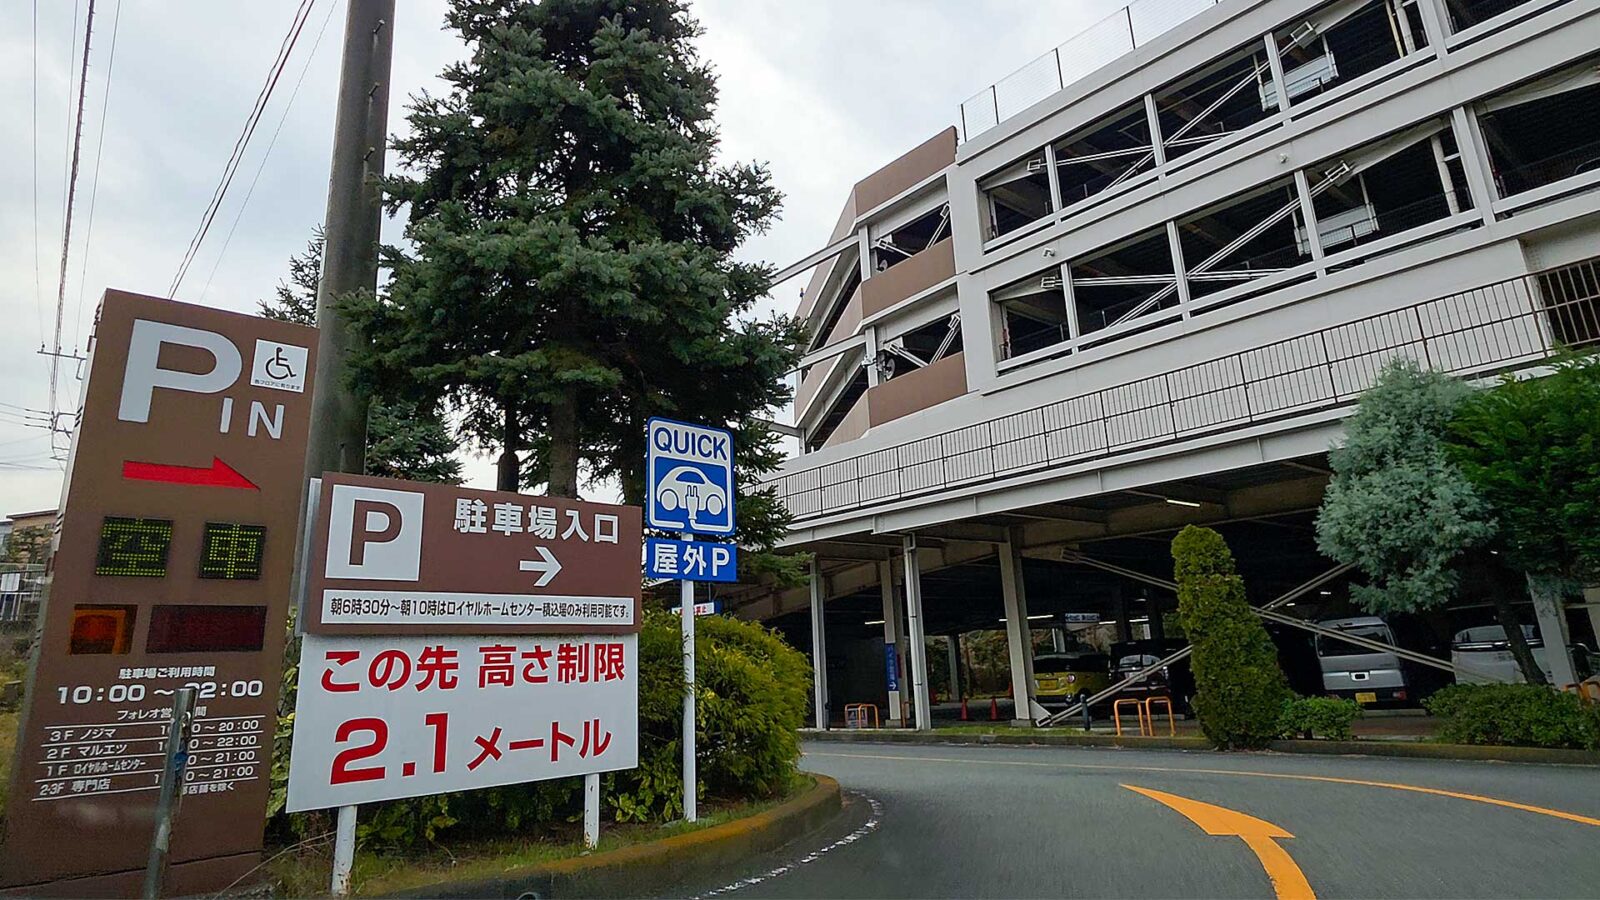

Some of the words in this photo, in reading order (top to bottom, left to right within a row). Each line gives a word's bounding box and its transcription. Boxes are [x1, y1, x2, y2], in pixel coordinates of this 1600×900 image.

[118, 319, 242, 423] P
[219, 397, 285, 440] IN
[653, 426, 728, 461] QUICK
[348, 497, 403, 568] P
[453, 498, 620, 545] 駐車場入口
[652, 543, 730, 577] 屋外P
[118, 666, 216, 680] 駐車場ご利用時間
[320, 645, 460, 693] この先
[477, 642, 627, 689] 高さ制限
[117, 706, 207, 721] フォレオ営間
[50, 730, 74, 741] 3F
[79, 728, 116, 741] ノジマ
[47, 748, 71, 760] 2F
[77, 744, 127, 757] マルエツ
[47, 765, 68, 776] 1F
[71, 778, 112, 793] 専門店
